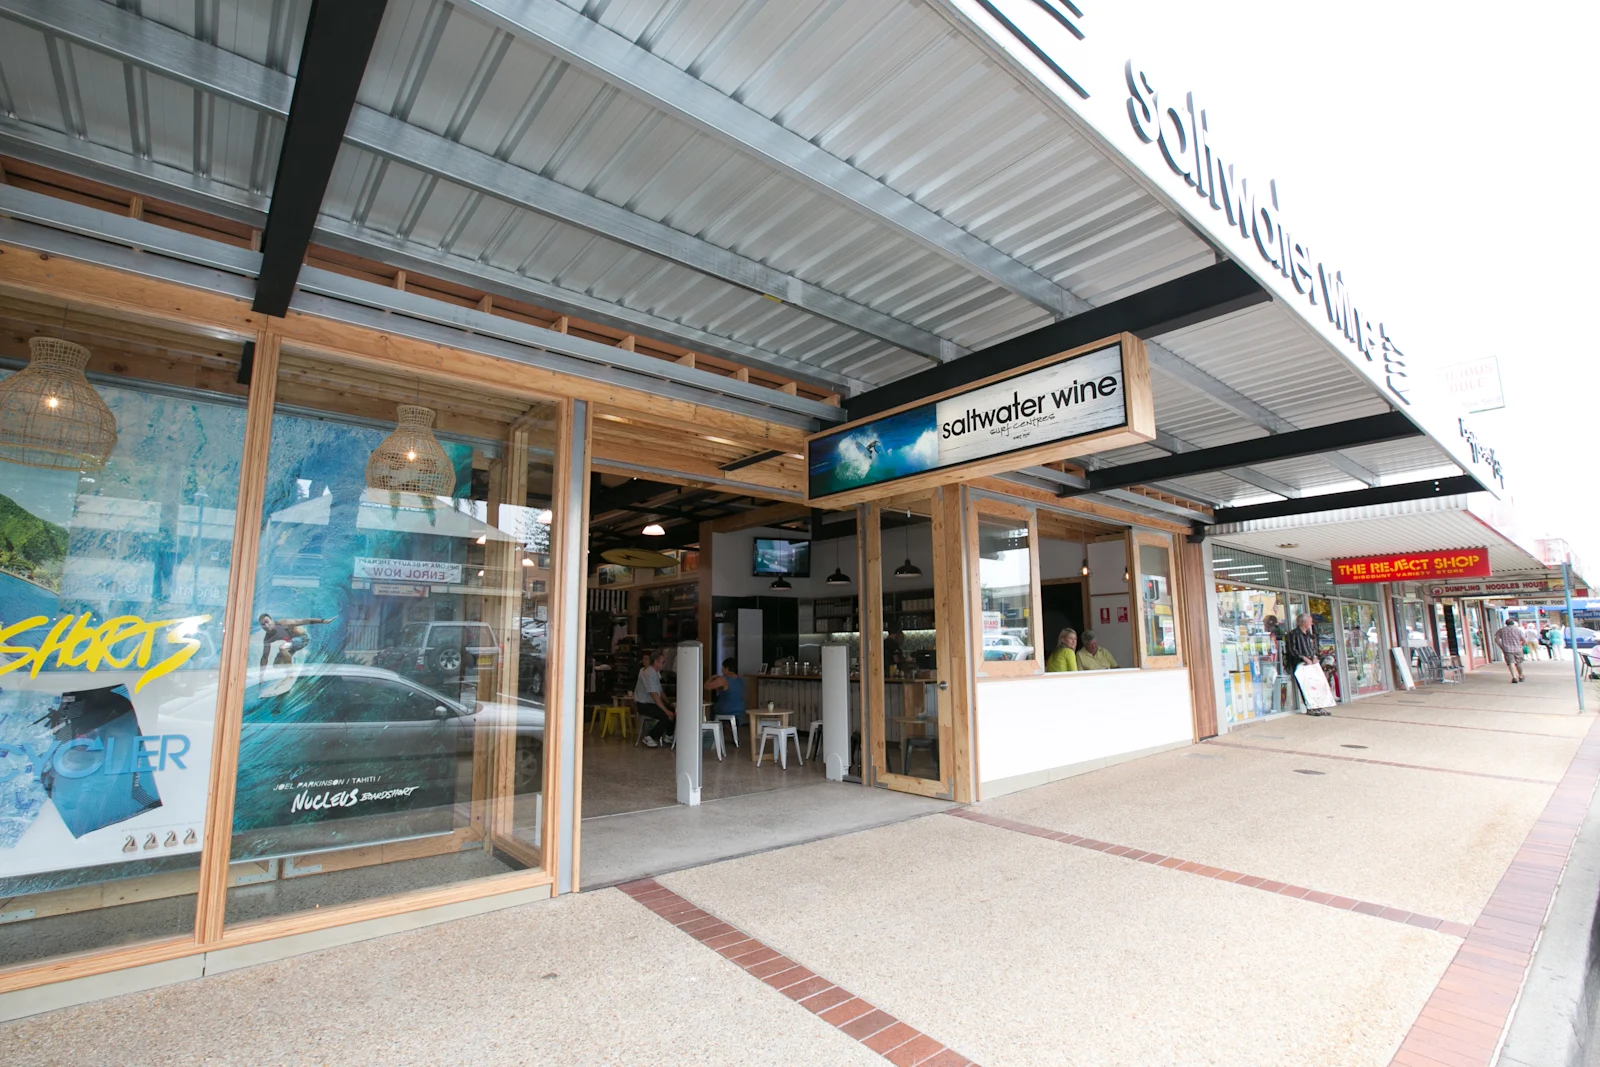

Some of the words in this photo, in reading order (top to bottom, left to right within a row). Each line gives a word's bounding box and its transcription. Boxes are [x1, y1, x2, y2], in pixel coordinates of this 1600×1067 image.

[942, 391, 1046, 440] saltwater
[1051, 375, 1118, 410] wine
[1337, 564, 1367, 576] THE
[1370, 558, 1430, 574] REJECT
[1433, 555, 1480, 569] SHOP
[1444, 584, 1481, 592] DUMPLING
[1485, 582, 1520, 590] NOODLES
[1522, 580, 1549, 589] HOUSE
[273, 783, 295, 791] JOEL
[296, 778, 346, 790] PARKINSON
[352, 776, 376, 785] TAHITI
[291, 788, 359, 813] NUCLEUS
[359, 786, 420, 802] BOARDSHORT
